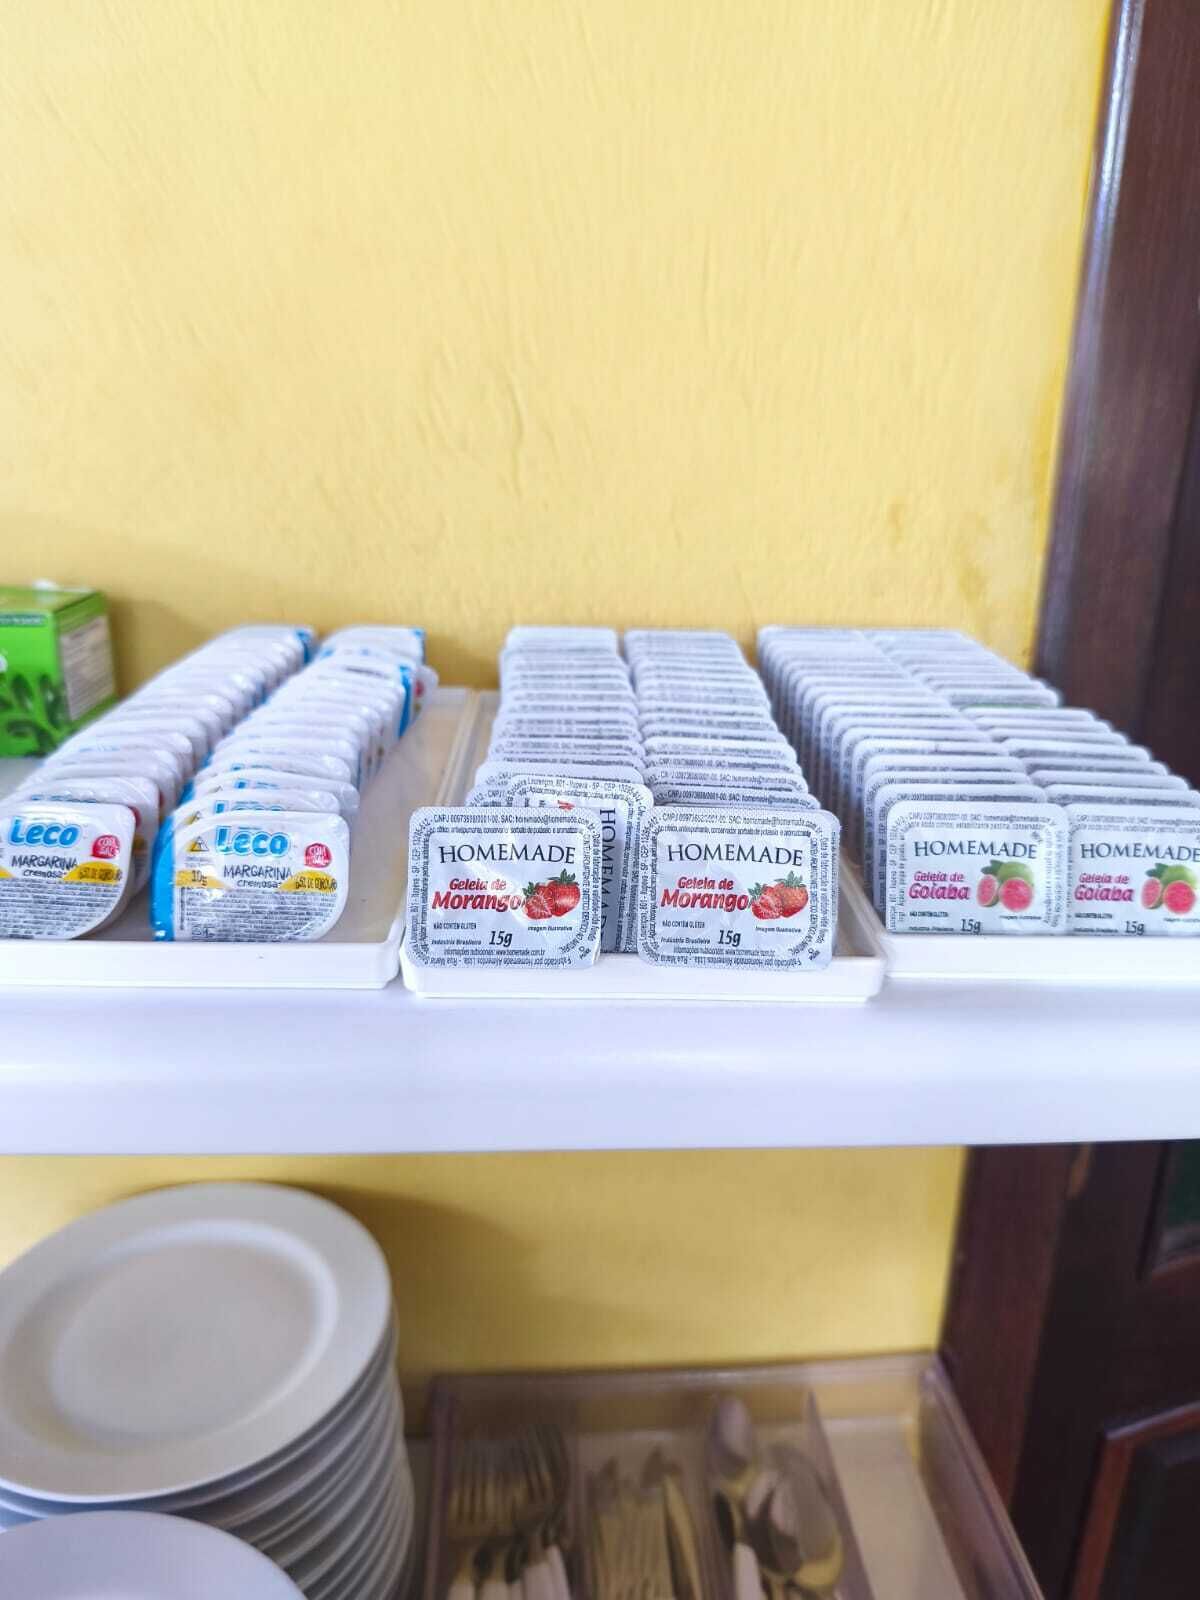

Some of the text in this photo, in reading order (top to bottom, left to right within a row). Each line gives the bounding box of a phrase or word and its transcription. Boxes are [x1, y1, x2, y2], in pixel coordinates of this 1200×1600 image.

[501, 815, 515, 823] SAC:
[9, 816, 81, 847] Leco
[216, 826, 290, 857] Leco
[914, 840, 1038, 859] HOMEMADE
[439, 843, 576, 865] HOMEMADE
[667, 843, 804, 867] HOMEMADE
[1080, 842, 1200, 862] HOMEMADE
[11, 855, 78, 870] MARGARINA
[23, 868, 63, 878] cremosa
[223, 864, 293, 880] MARGARINA
[914, 870, 965, 882] Geleia de
[1078, 872, 1130, 885] Geleia de
[236, 878, 278, 889] cremosa
[449, 878, 507, 891] Geleia de
[677, 876, 734, 890] Geleia de
[908, 882, 971, 901] Goiaba
[660, 889, 752, 913] Morango
[1074, 884, 1135, 902] Goiaba
[431, 891, 525, 913] Morango
[960, 918, 982, 935] 15g
[1124, 920, 1146, 936] 15g
[488, 930, 514, 948] 15g
[718, 930, 741, 947] 15g
